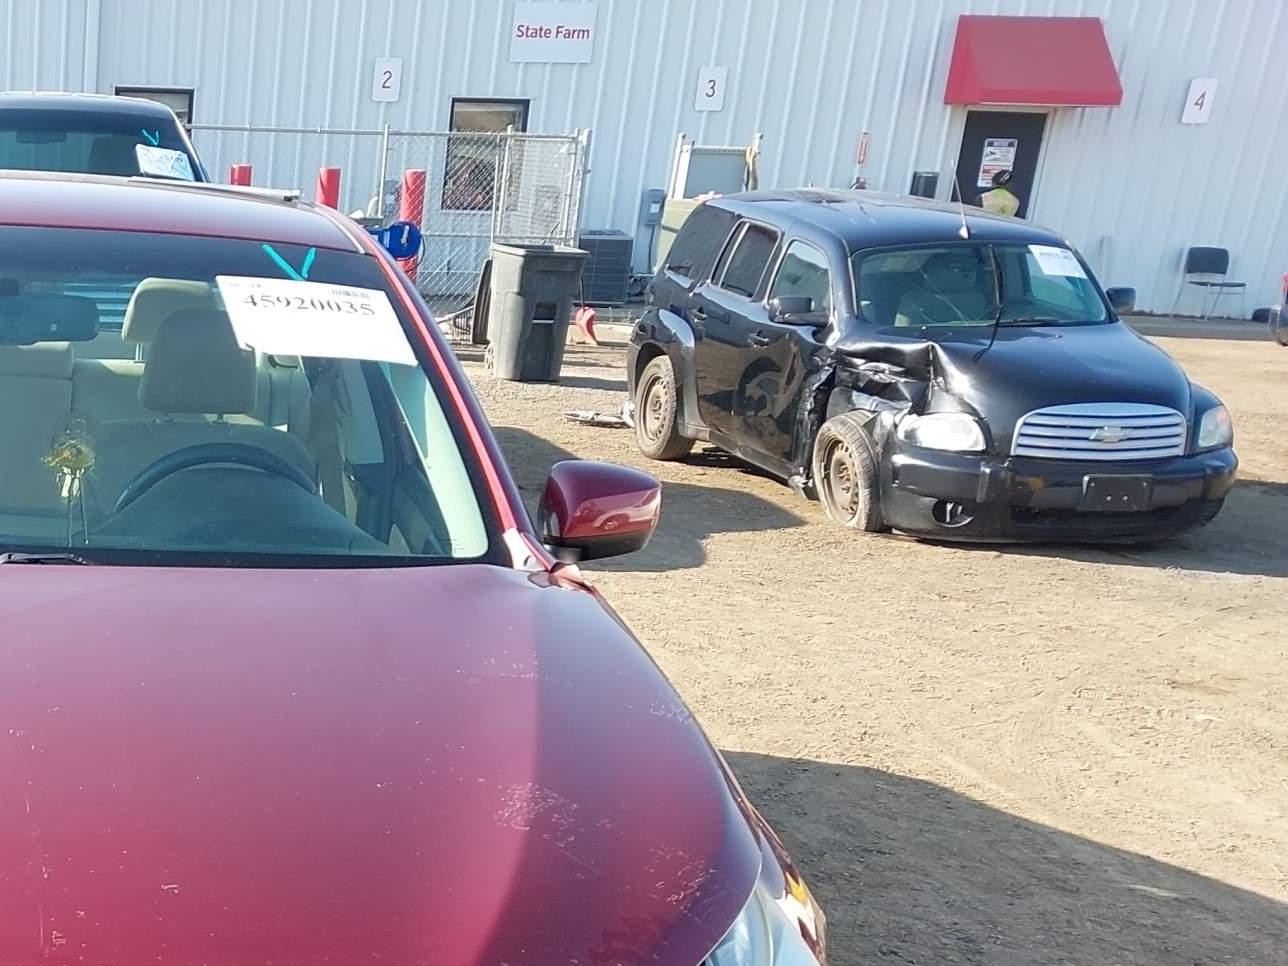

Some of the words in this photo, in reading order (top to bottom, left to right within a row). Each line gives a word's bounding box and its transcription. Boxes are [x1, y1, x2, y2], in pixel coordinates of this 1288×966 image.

[516, 24, 552, 39] State
[555, 25, 590, 40] Farm
[381, 70, 393, 89] 2
[705, 79, 717, 98] 3
[1193, 90, 1207, 111] 4
[244, 293, 375, 316] 45920035
